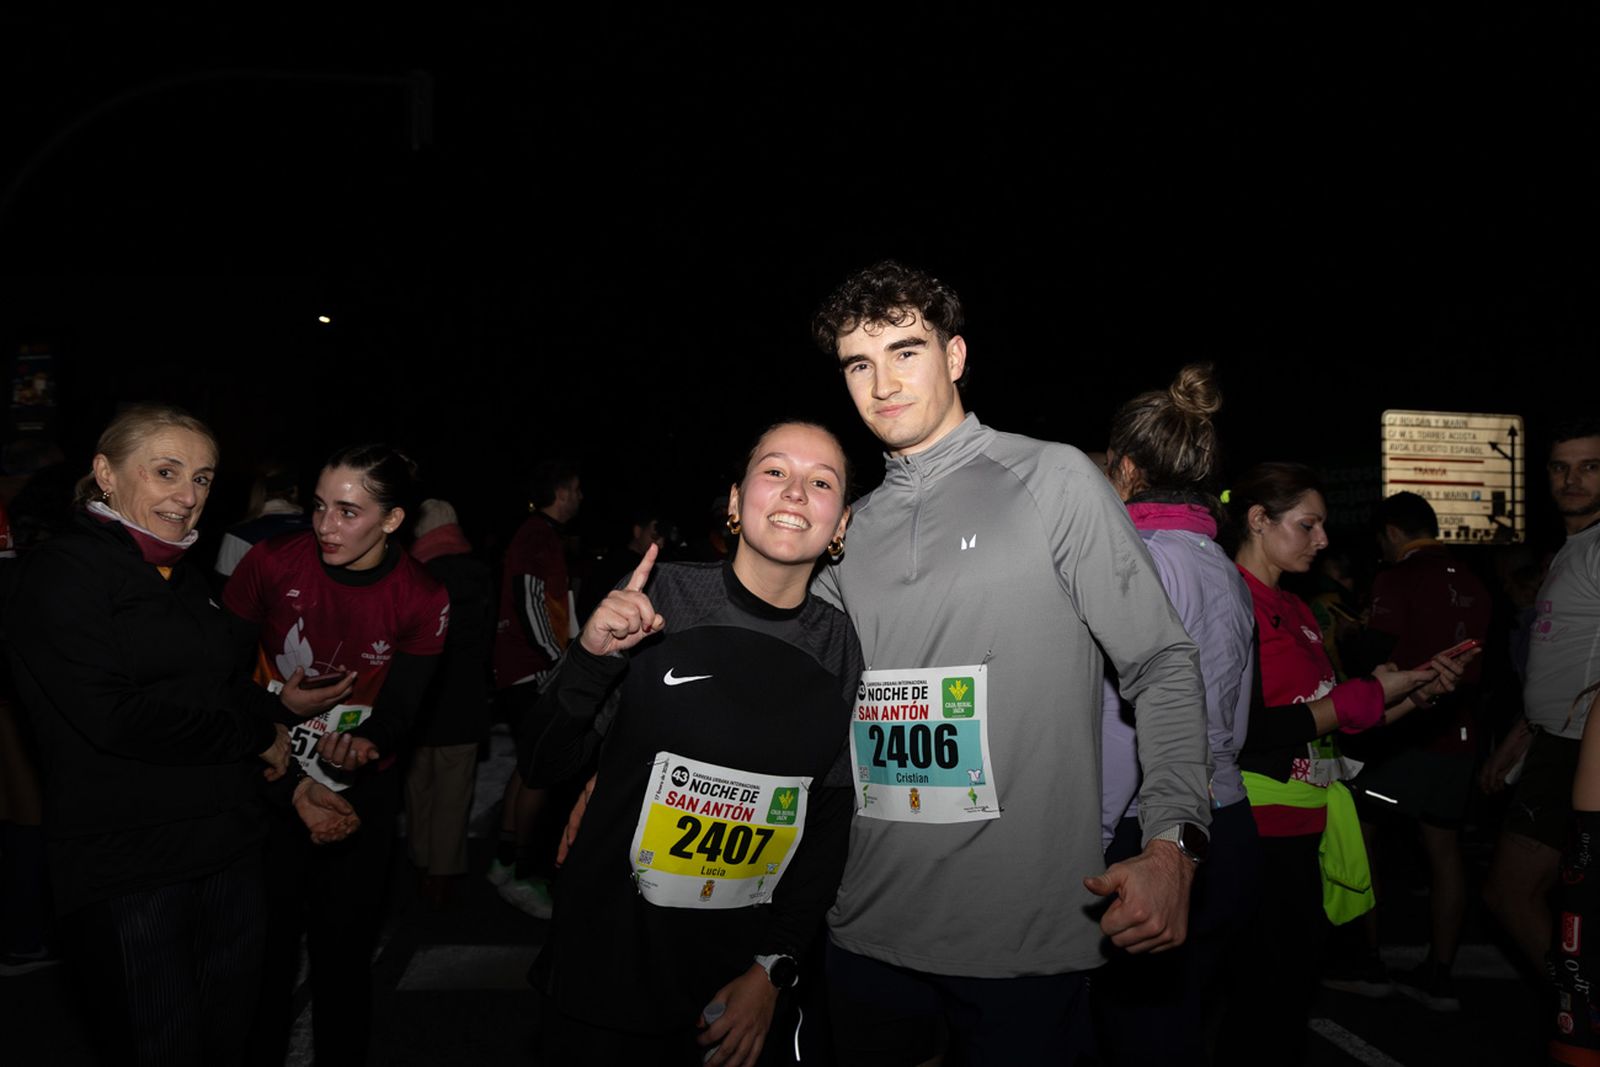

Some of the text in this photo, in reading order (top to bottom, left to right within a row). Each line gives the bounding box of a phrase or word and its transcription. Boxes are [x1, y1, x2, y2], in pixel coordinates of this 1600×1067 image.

[868, 686, 928, 701] NOCHE DE
[859, 705, 878, 720] SAN
[881, 701, 929, 720] ANTÓN
[868, 723, 959, 769] 2406
[672, 769, 689, 782] 43
[896, 772, 929, 784] Cristian
[689, 779, 760, 804] NOCHE DE
[729, 780, 761, 790] INTERNACIONAL
[665, 790, 755, 822] SAN ANTÓN
[669, 815, 775, 865] 2407
[700, 865, 726, 877] Lucía
